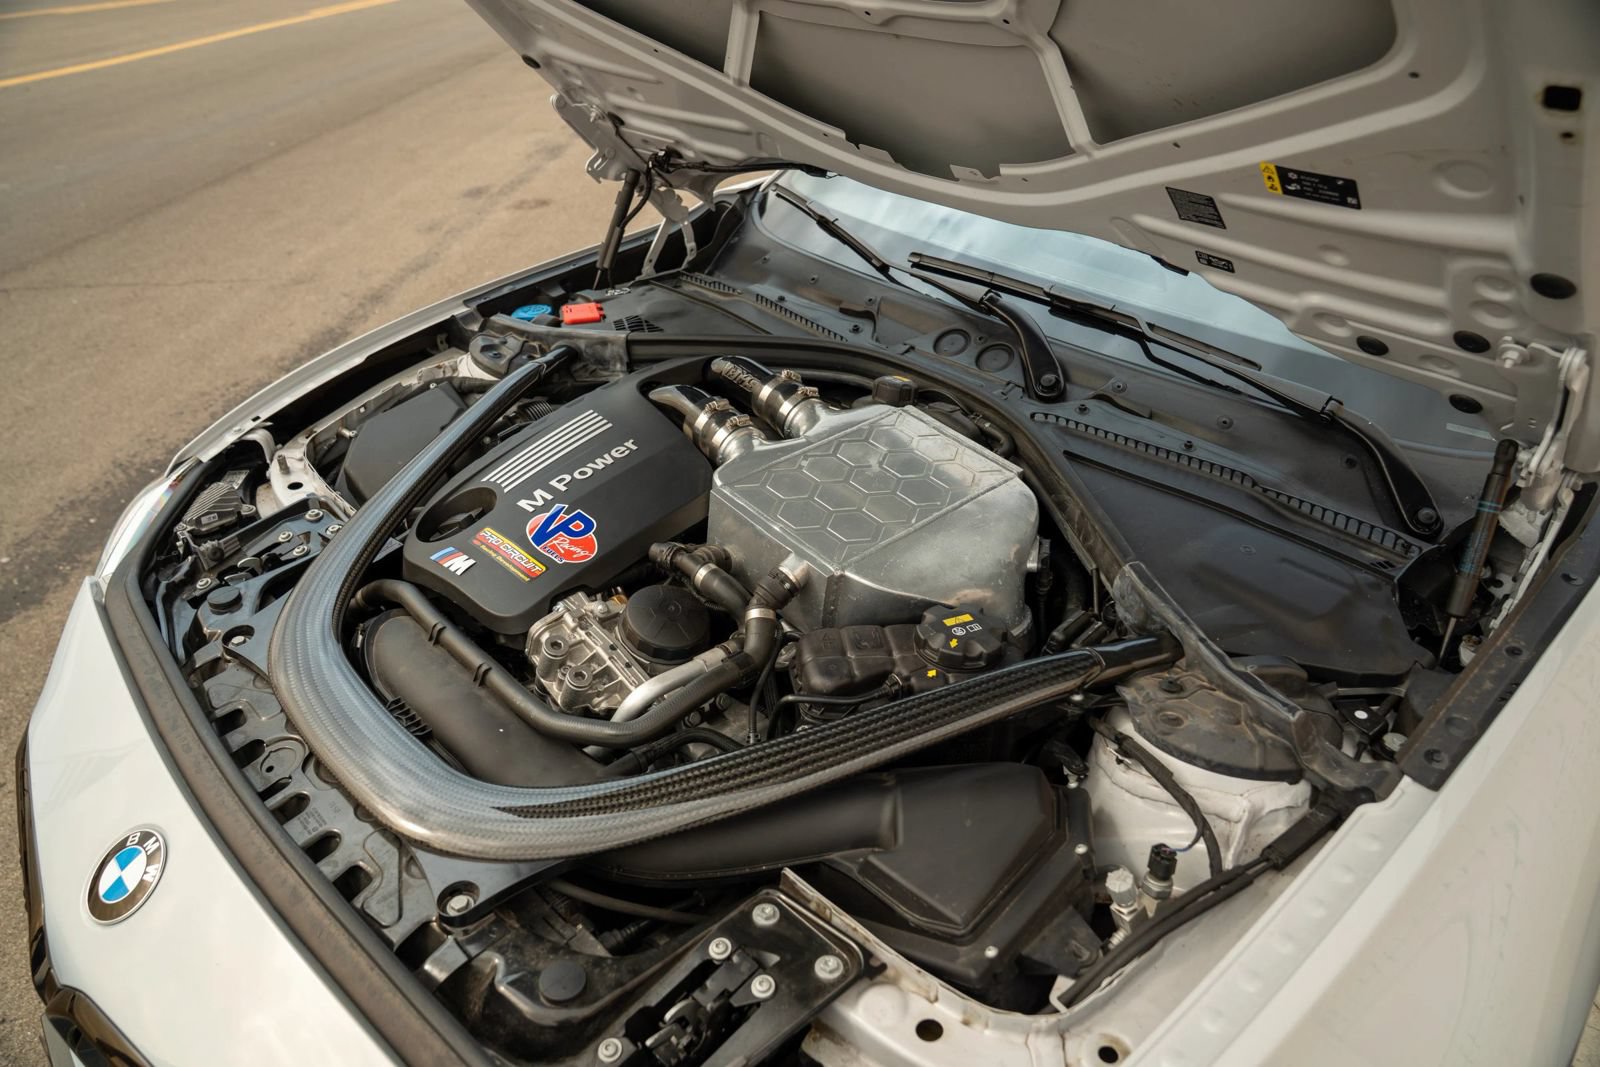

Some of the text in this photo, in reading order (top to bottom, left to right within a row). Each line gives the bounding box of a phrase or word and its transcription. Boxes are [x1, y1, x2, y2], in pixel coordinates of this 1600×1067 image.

[516, 439, 639, 513] M Power
[530, 503, 597, 548] VP
[443, 554, 476, 576] M
[480, 530, 542, 572] PRO CIRCUIT
[542, 545, 565, 563] FUELS
[547, 536, 593, 558] Racing
[126, 832, 161, 882] BMW
